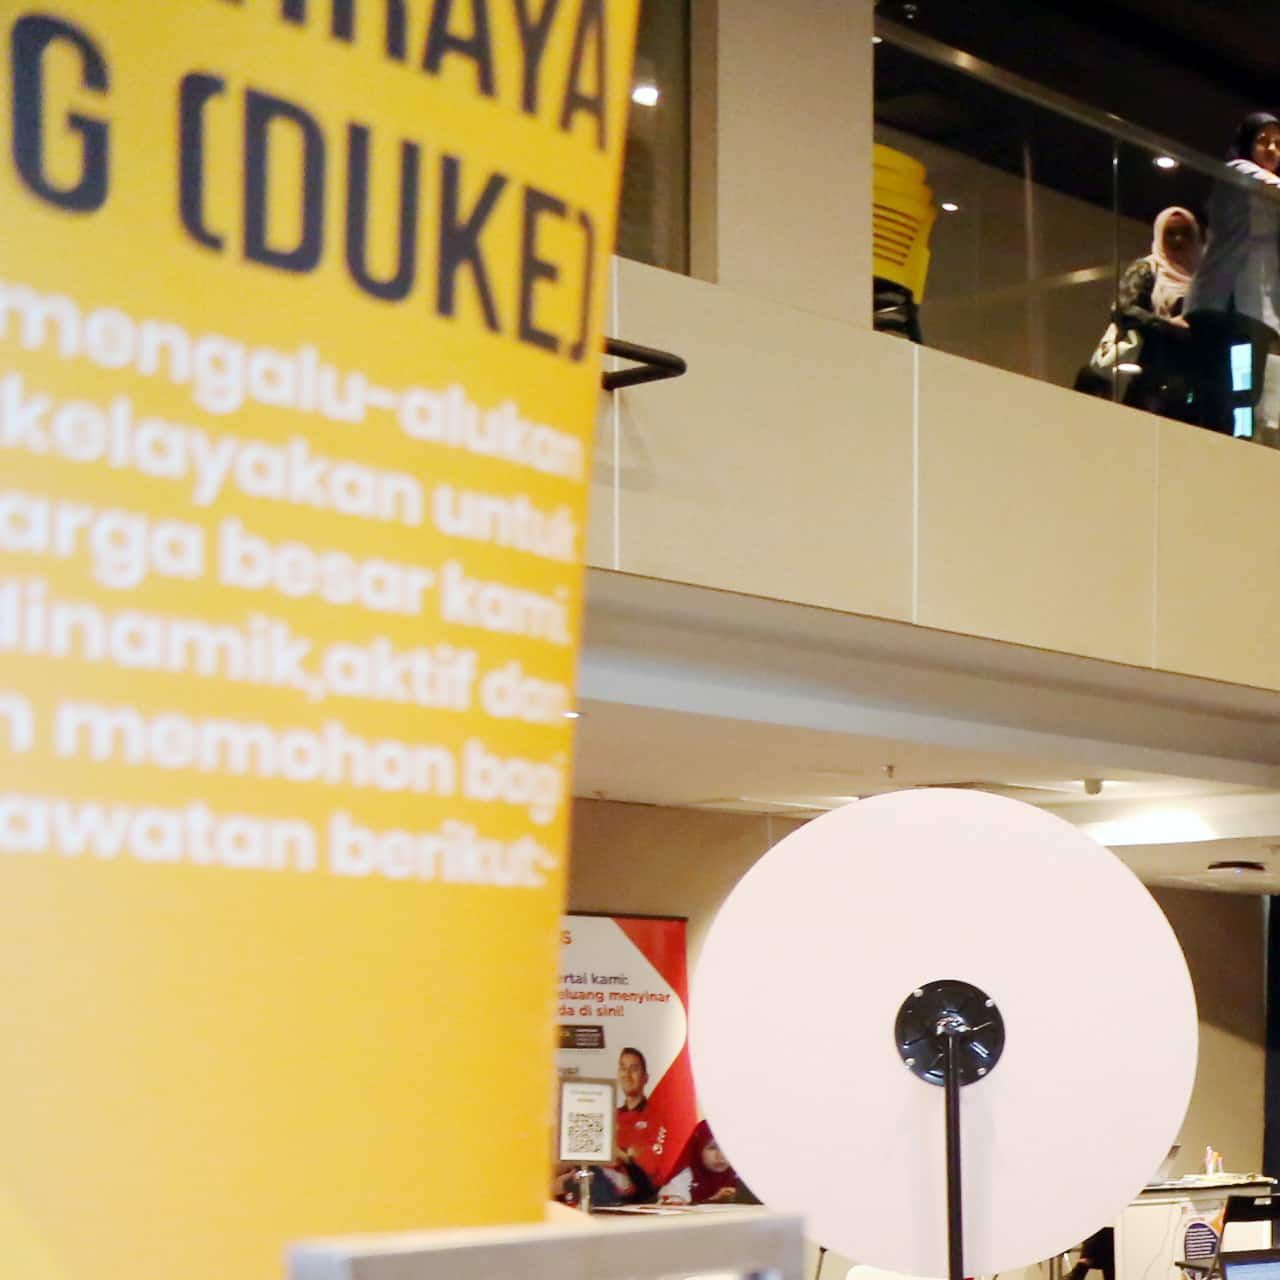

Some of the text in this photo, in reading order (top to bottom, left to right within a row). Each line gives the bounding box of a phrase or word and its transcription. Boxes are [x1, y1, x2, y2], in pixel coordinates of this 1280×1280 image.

[208, 0, 607, 152] AYA
[178, 68, 597, 363] (DUKE)
[217, 515, 434, 615] besar
